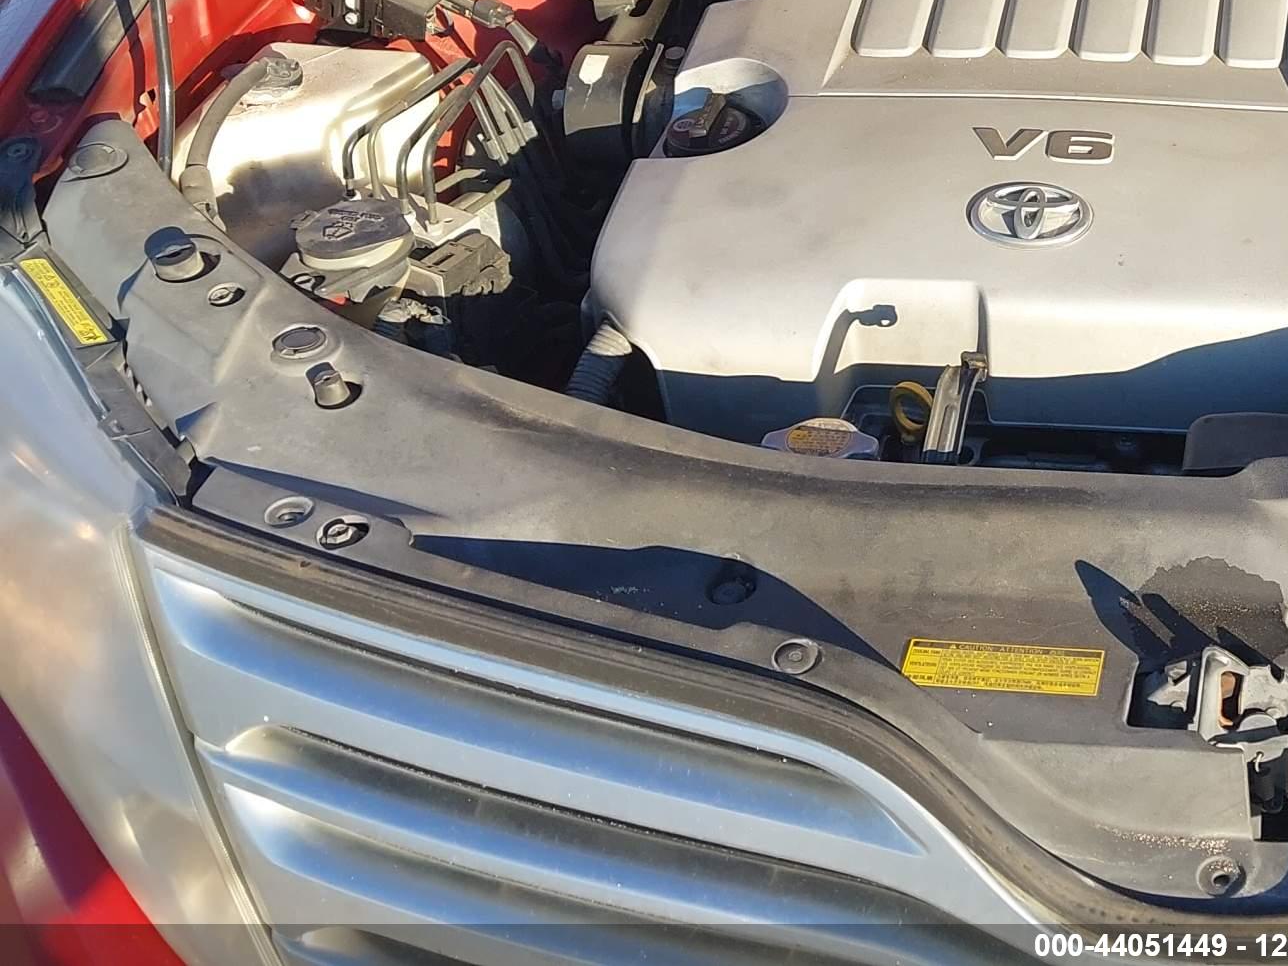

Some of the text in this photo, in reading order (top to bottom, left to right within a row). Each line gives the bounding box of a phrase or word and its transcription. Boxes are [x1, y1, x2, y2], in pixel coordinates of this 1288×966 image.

[972, 127, 1115, 164] V6
[958, 644, 993, 653] CAUTION
[999, 646, 1044, 655] ATTENTION
